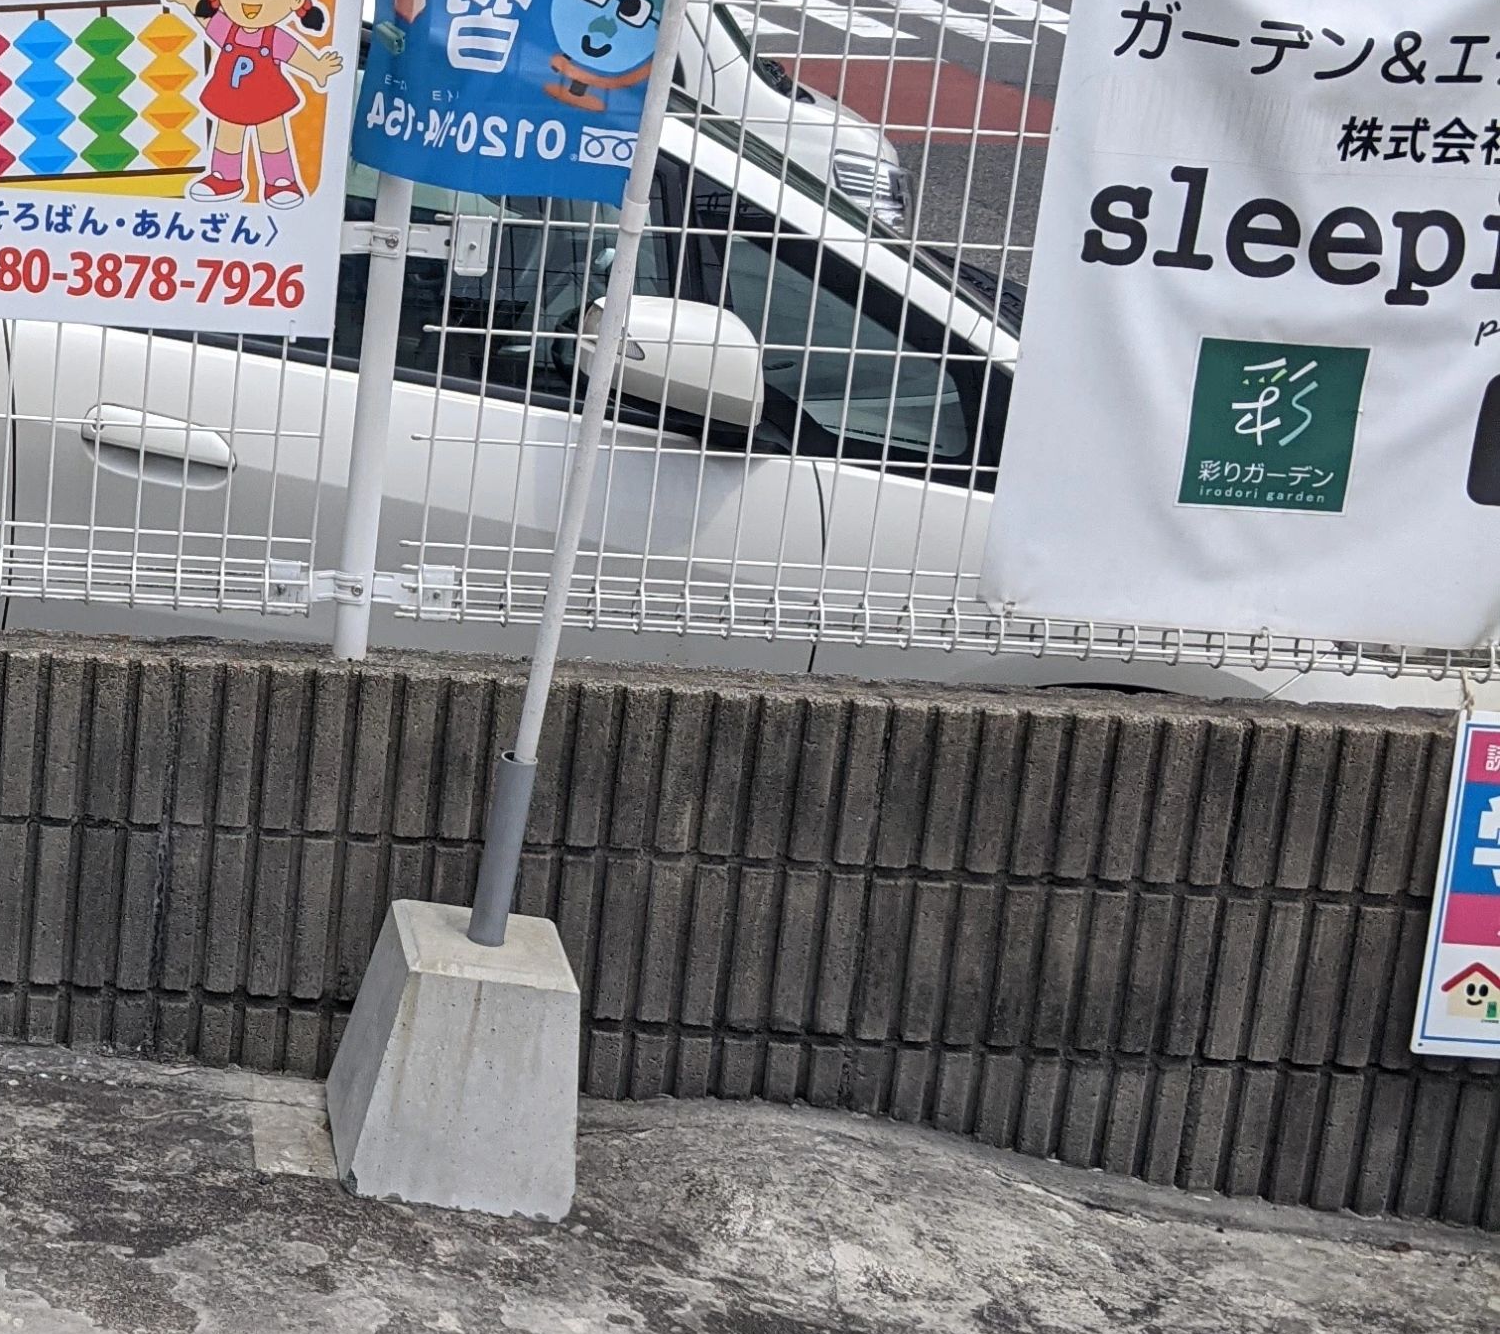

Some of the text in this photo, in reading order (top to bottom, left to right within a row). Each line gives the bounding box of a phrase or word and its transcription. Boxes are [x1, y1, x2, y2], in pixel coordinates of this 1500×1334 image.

[231, 55, 255, 90] P
[1198, 459, 1335, 488] 彩りガーデン
[1199, 485, 1326, 504] irodori garden
